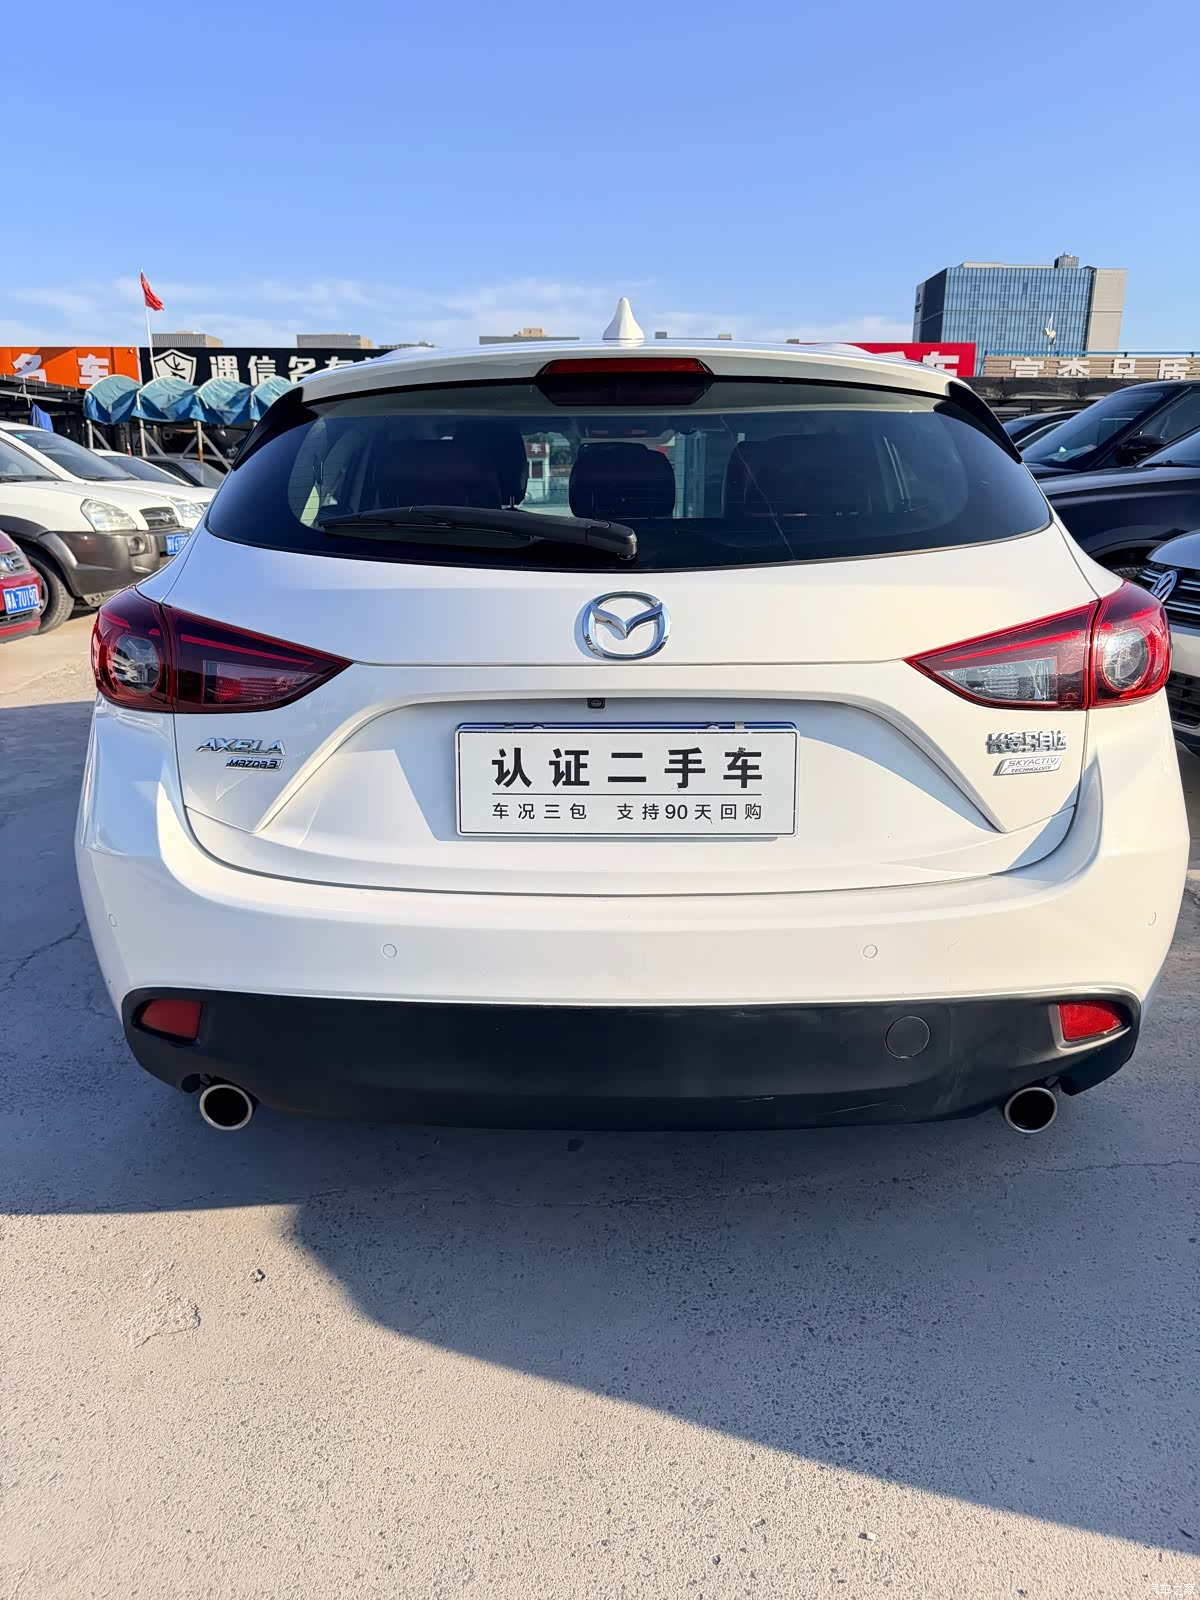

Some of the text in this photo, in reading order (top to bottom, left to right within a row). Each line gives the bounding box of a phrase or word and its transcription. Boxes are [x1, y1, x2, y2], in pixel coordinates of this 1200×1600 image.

[12, 353, 110, 384] 名车
[196, 737, 286, 756] AXELA
[492, 747, 763, 789] 认证二手车
[1007, 757, 1057, 767] SKYACTIV
[1010, 765, 1052, 773] TECHNOLOGY
[492, 802, 762, 821] 车况三包 支持90天回购
